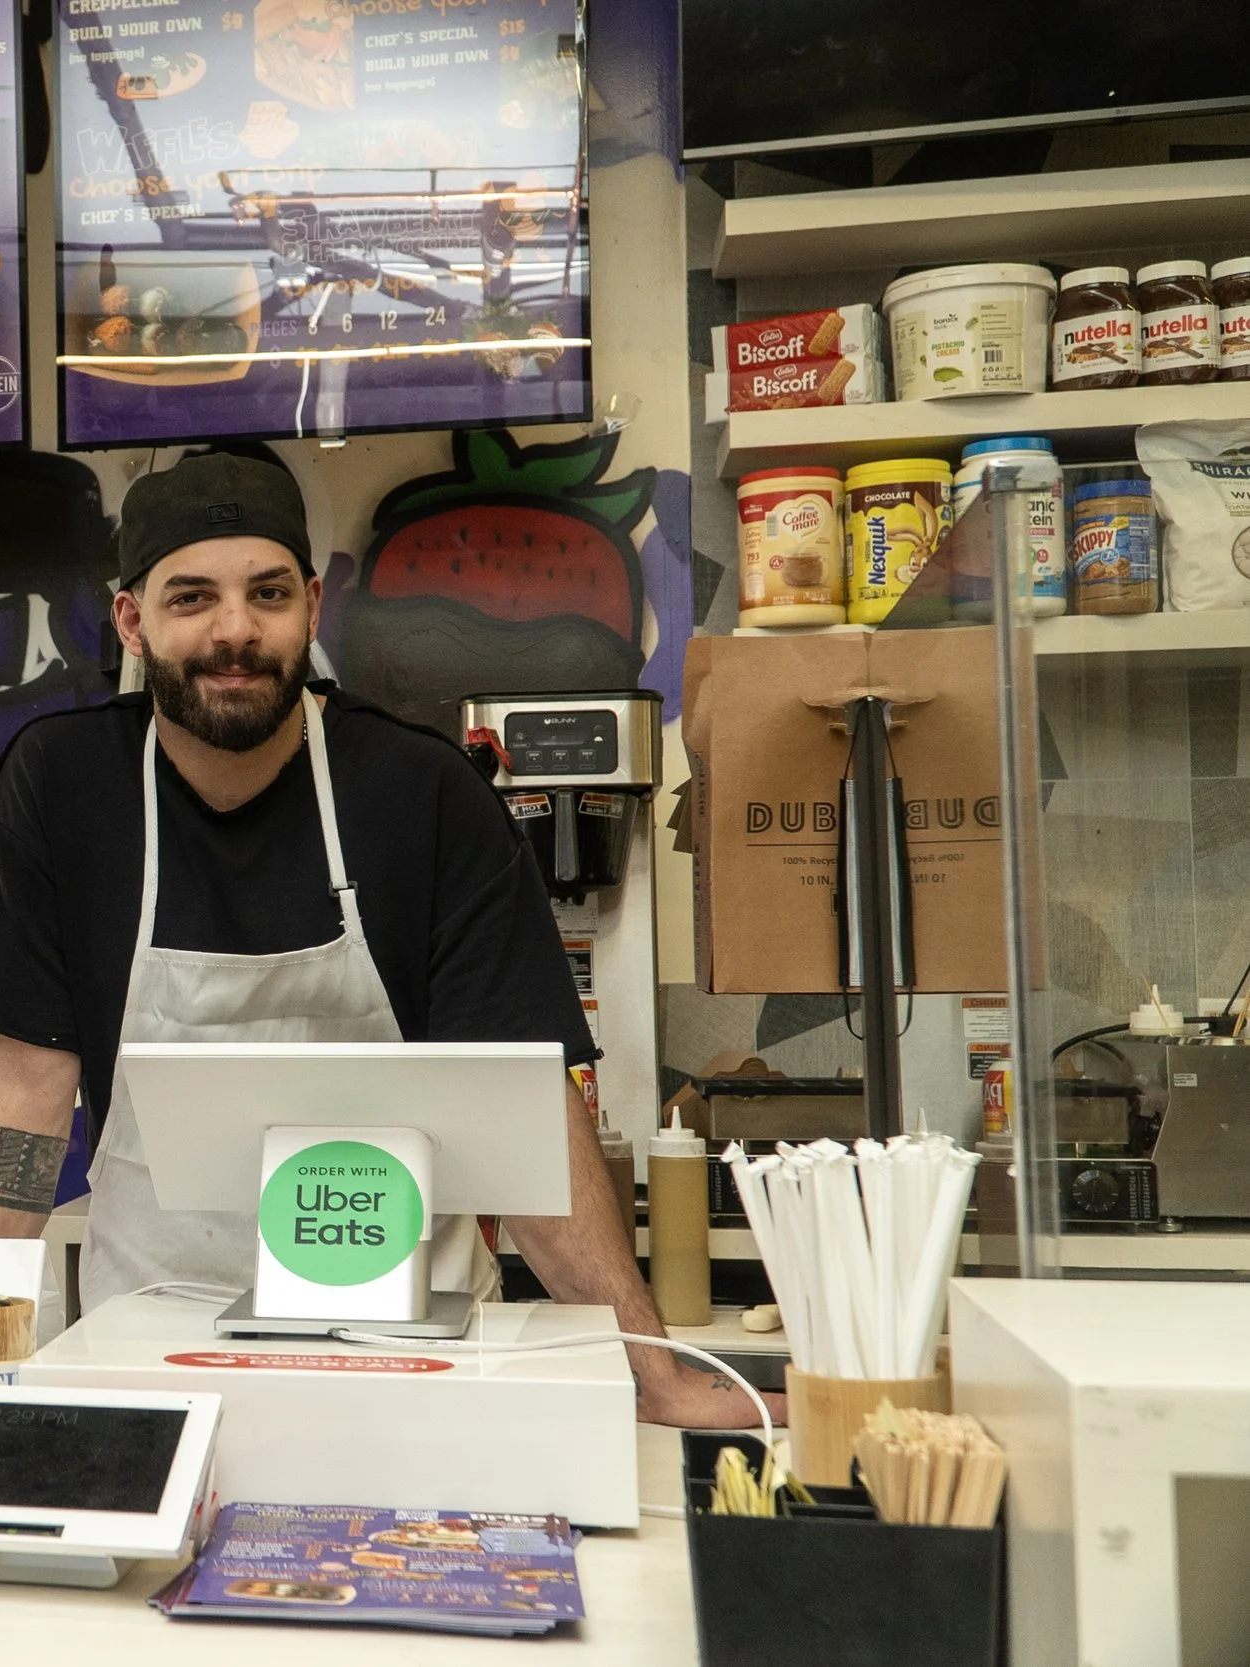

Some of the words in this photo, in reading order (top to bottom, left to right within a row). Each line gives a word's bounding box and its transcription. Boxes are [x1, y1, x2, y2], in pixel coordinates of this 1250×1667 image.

[69, 25, 113, 42] BUILD
[118, 20, 160, 36] YOUR
[166, 17, 203, 33] OWN
[419, 26, 478, 44] SPECIAL
[365, 57, 405, 72] BUILD
[412, 53, 449, 68] YOUR
[455, 49, 489, 64] OWN
[69, 175, 176, 198] Choose
[141, 204, 205, 221] SPECIAL
[281, 208, 482, 241] STRAWBERRY
[342, 313, 352, 333] 6
[379, 310, 398, 330] 12
[425, 305, 447, 326] 24
[1141, 314, 1208, 340] nutella
[1064, 320, 1131, 347] nutella
[737, 333, 803, 366] Biscoff
[931, 340, 965, 351] PISTACHIO
[936, 348, 960, 358] CREAM
[753, 368, 816, 397] Biscoff
[864, 491, 910, 503] CHOCOLATE
[782, 508, 819, 526] Coffee
[792, 517, 820, 532] mate
[866, 515, 892, 586] Nesquik
[1070, 529, 1114, 562] SKIPPY
[521, 804, 542, 813] HOT
[746, 802, 837, 833] DUB
[782, 857, 807, 865] 100%
[810, 857, 837, 866] Recyc
[801, 876, 814, 885] 10
[817, 876, 834, 885] IN.
[298, 1166, 345, 1177] ORDER
[350, 1167, 387, 1177] WITH
[296, 1184, 386, 1212] Uber
[294, 1217, 385, 1246] Eats
[249, 1359, 429, 1370] DOORDASH
[41, 1411, 80, 1425] PM
